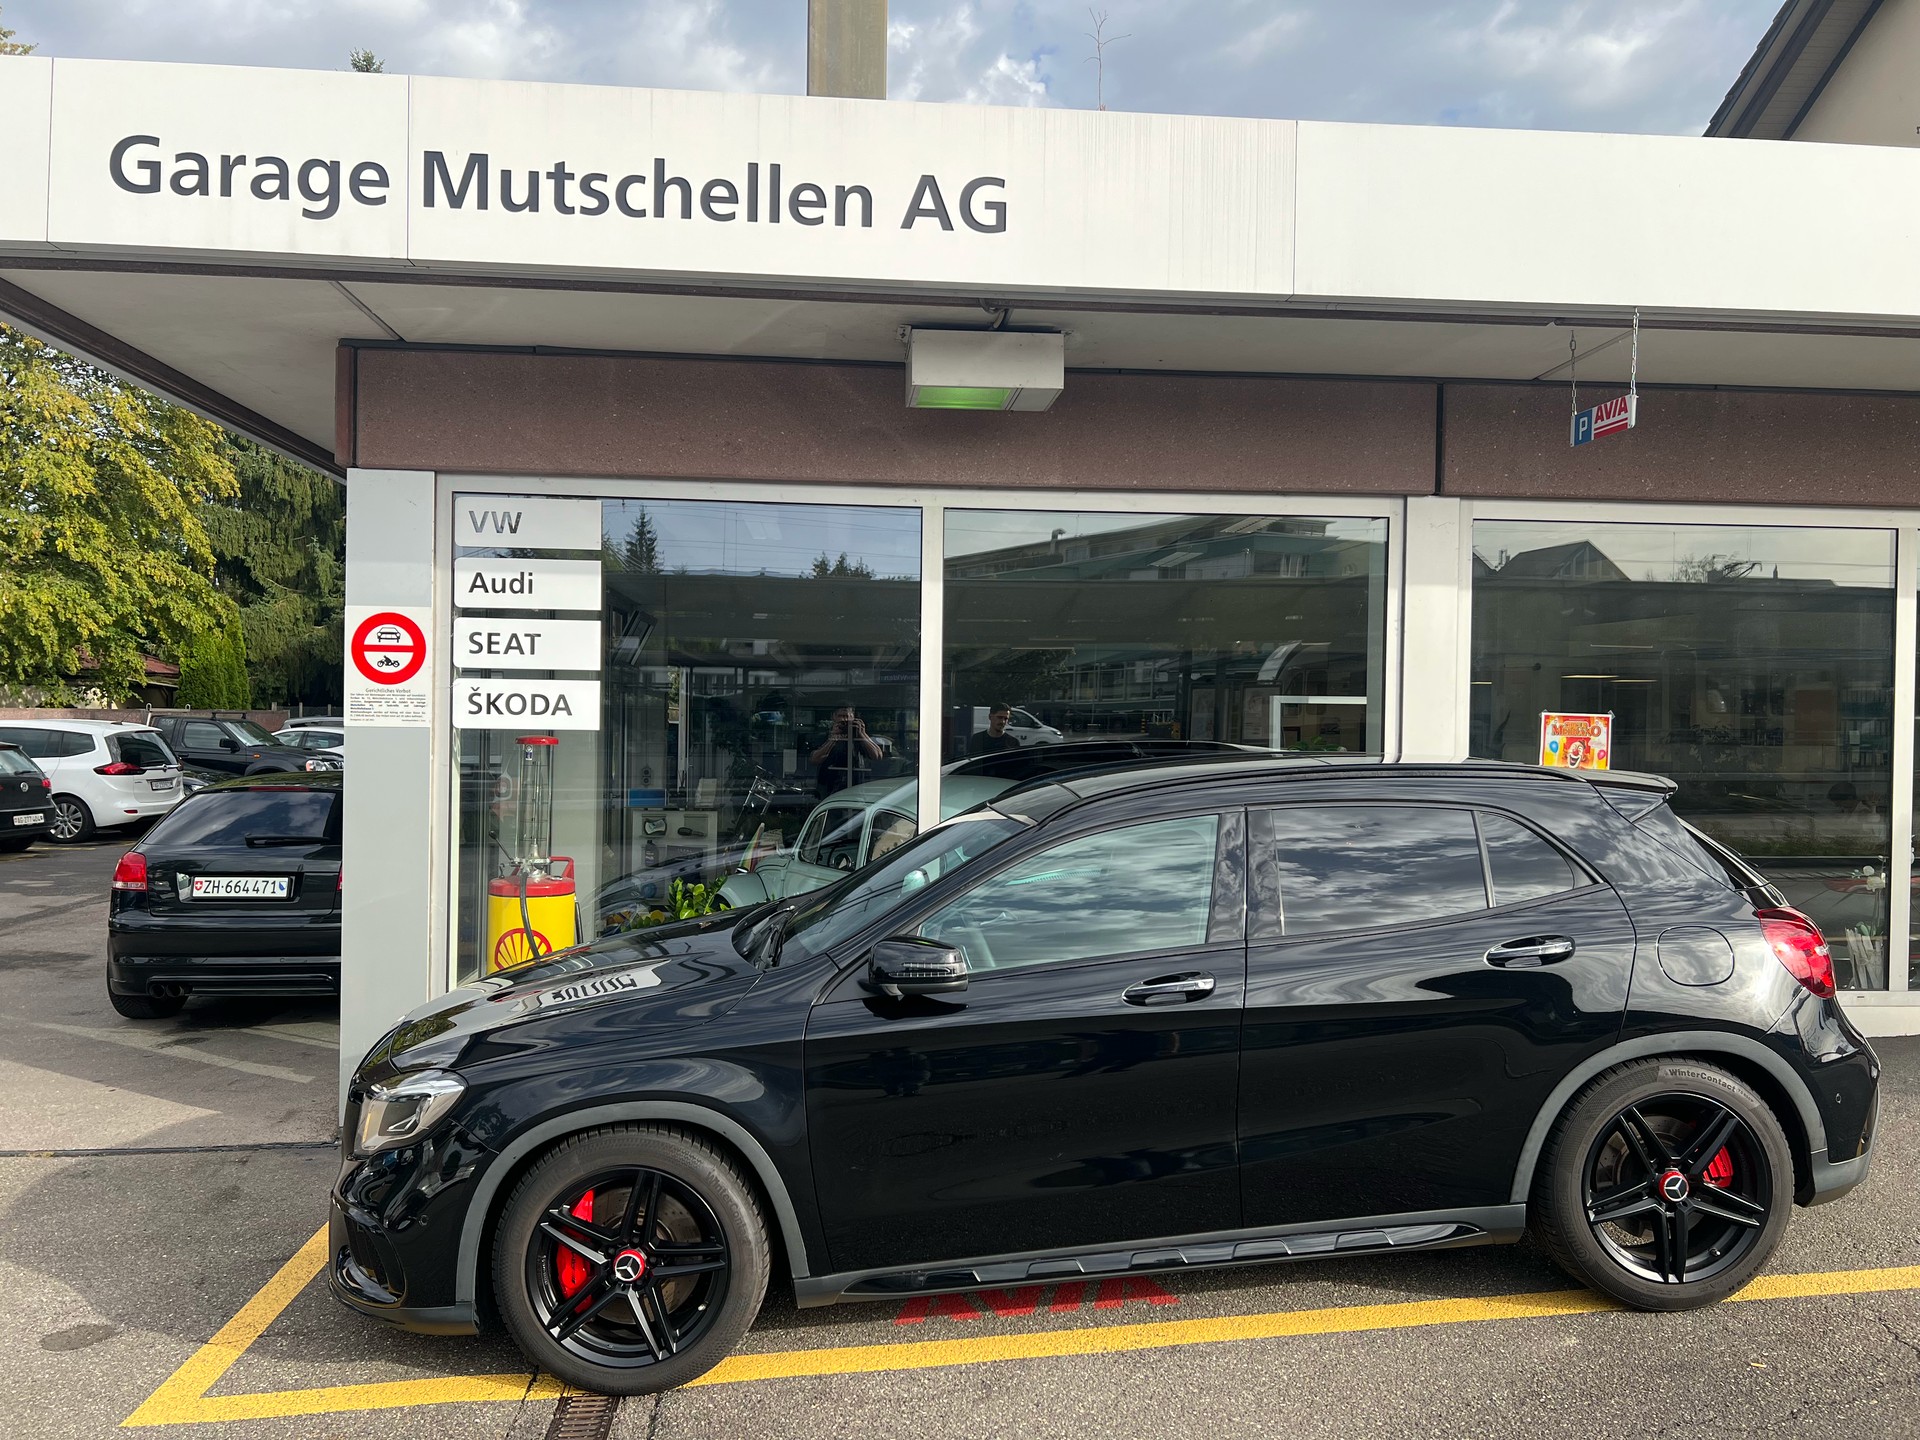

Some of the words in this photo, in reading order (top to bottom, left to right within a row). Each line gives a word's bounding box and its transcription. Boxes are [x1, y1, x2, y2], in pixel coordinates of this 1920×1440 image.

[109, 134, 390, 220] Garage
[423, 150, 873, 228] Mutschellen
[900, 174, 1008, 234] AG
[1579, 416, 1588, 441] P
[1594, 396, 1628, 424] AVIA
[468, 510, 523, 534] VW
[468, 571, 533, 595] Audi
[468, 631, 542, 655] SEAT
[468, 686, 573, 716] ŠKODA
